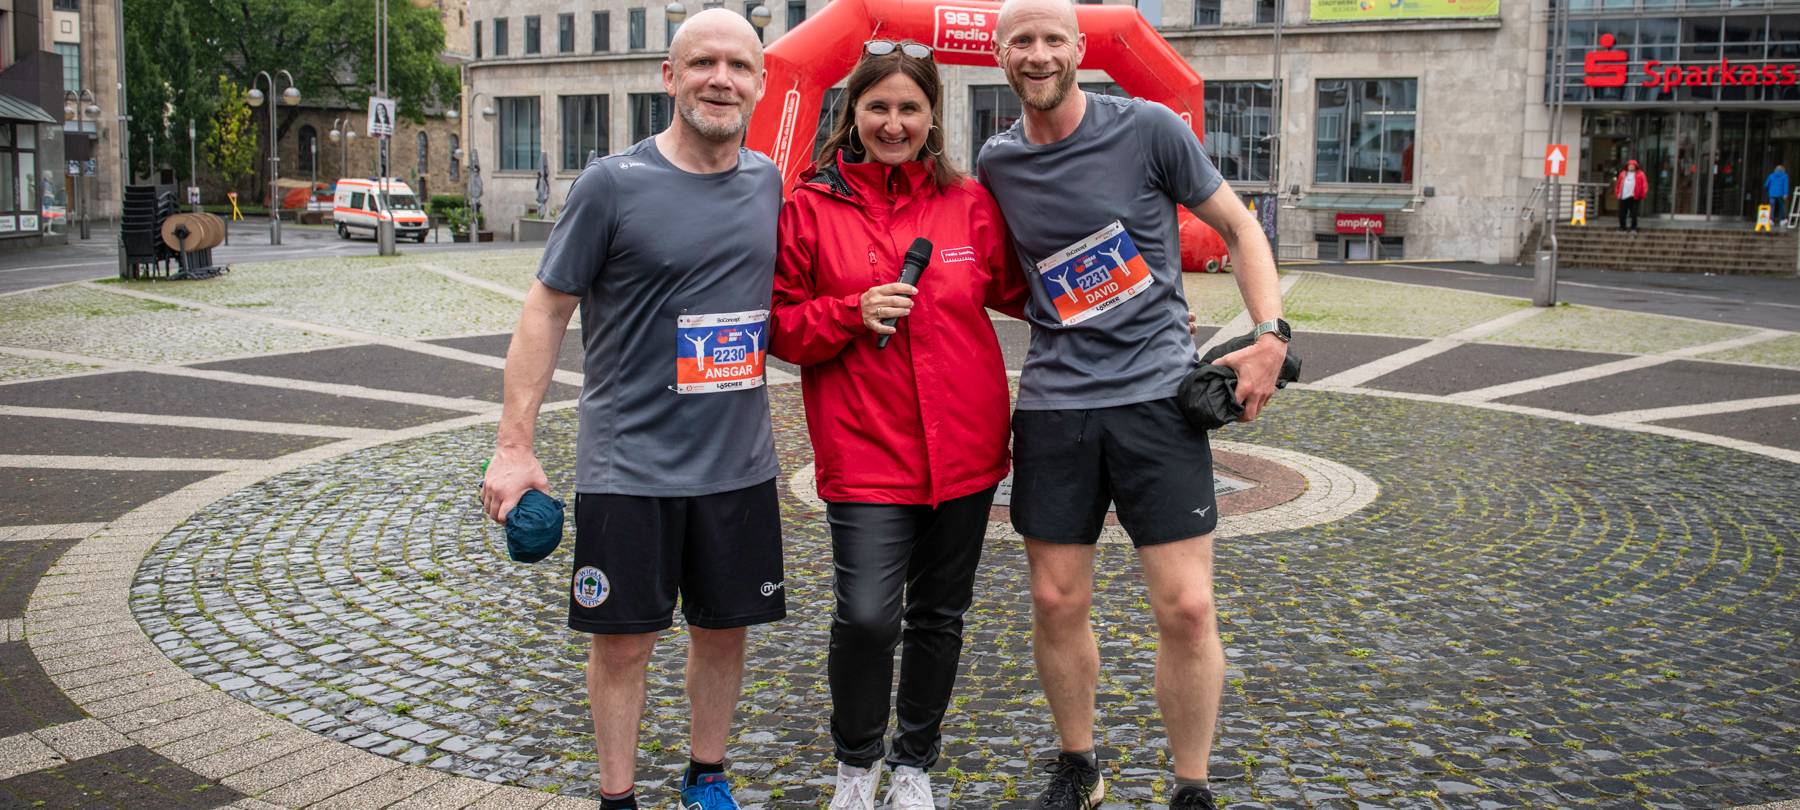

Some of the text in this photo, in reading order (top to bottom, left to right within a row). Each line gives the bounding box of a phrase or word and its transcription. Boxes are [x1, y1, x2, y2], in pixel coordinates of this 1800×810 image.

[944, 11, 986, 27] 98.5
[945, 27, 989, 42] radio
[1642, 57, 1800, 93] Sparkass
[1079, 268, 1109, 291] 2231
[1085, 282, 1119, 304] DAVID
[714, 348, 745, 363] 2230
[705, 364, 753, 379] ANSGAR
[579, 568, 602, 581] WIGAN
[576, 592, 601, 606] ATHLETIC
